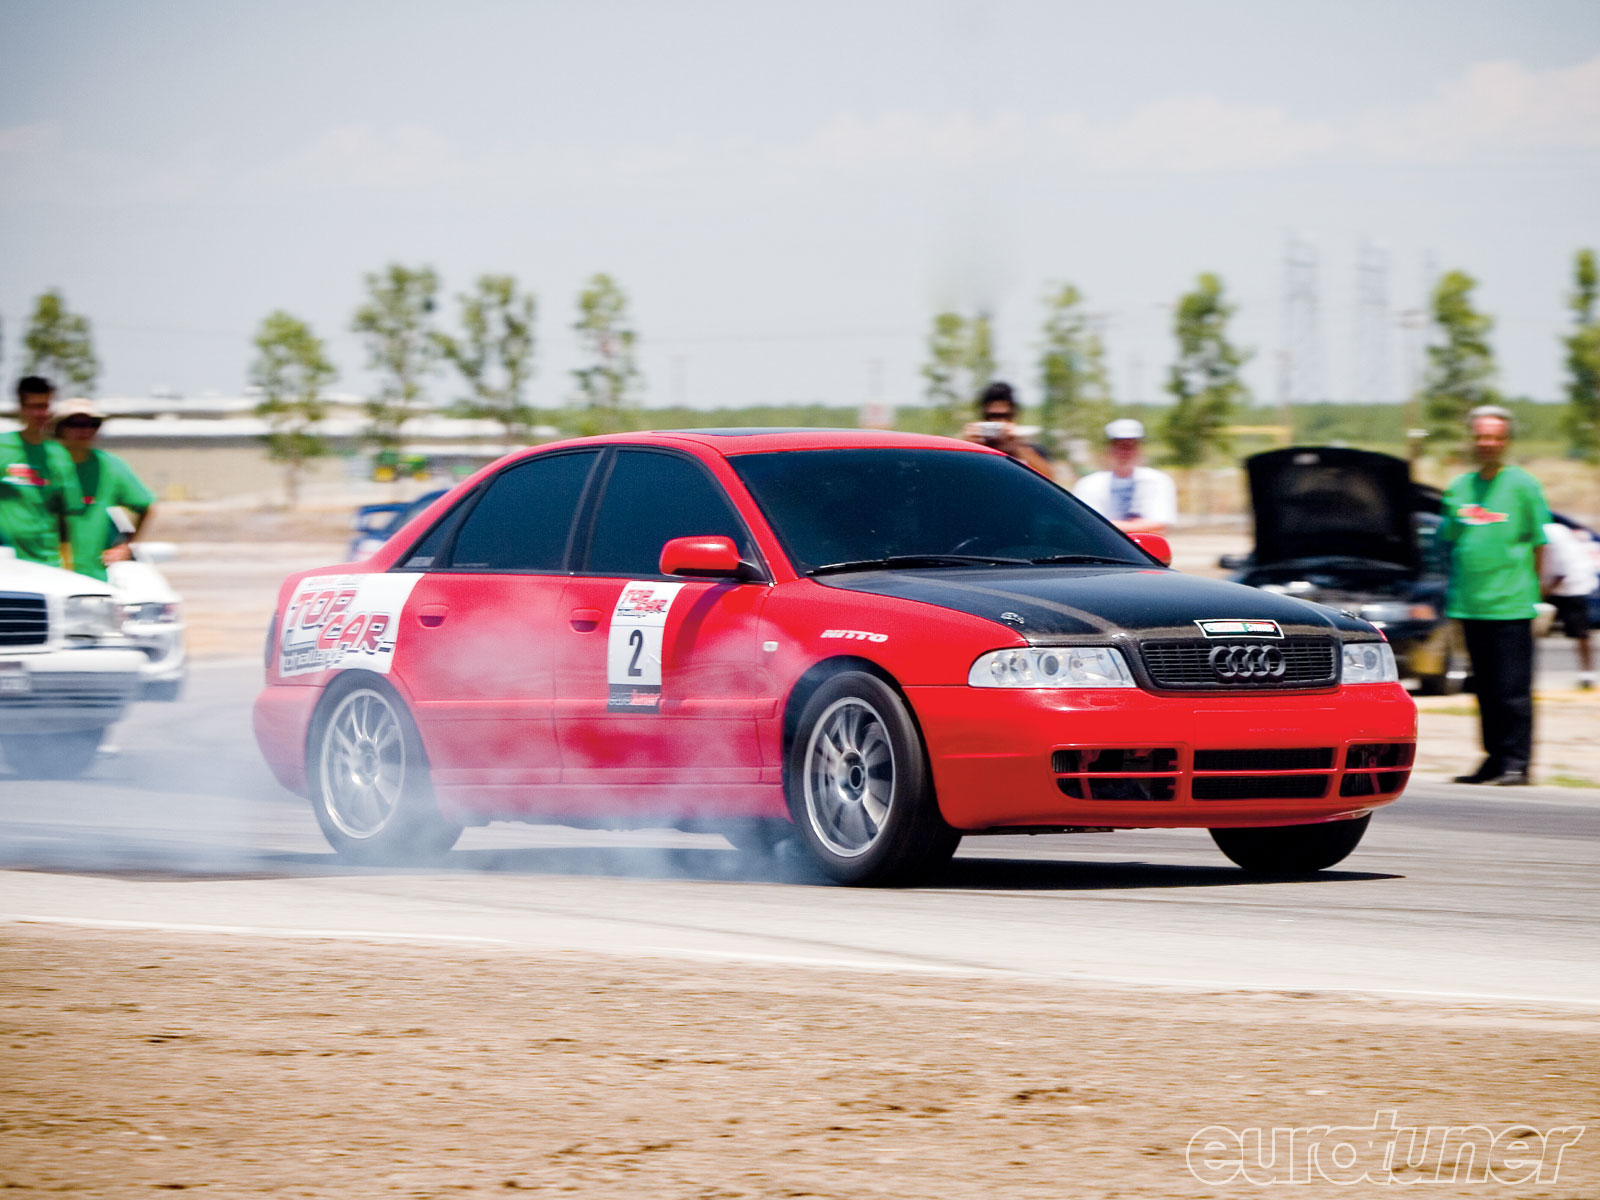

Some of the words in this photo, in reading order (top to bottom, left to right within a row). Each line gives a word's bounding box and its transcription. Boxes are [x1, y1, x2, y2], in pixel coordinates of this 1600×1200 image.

[289, 588, 358, 630] TOP
[317, 612, 391, 652] CAR
[820, 629, 889, 643] NITTO
[627, 629, 644, 677] 2
